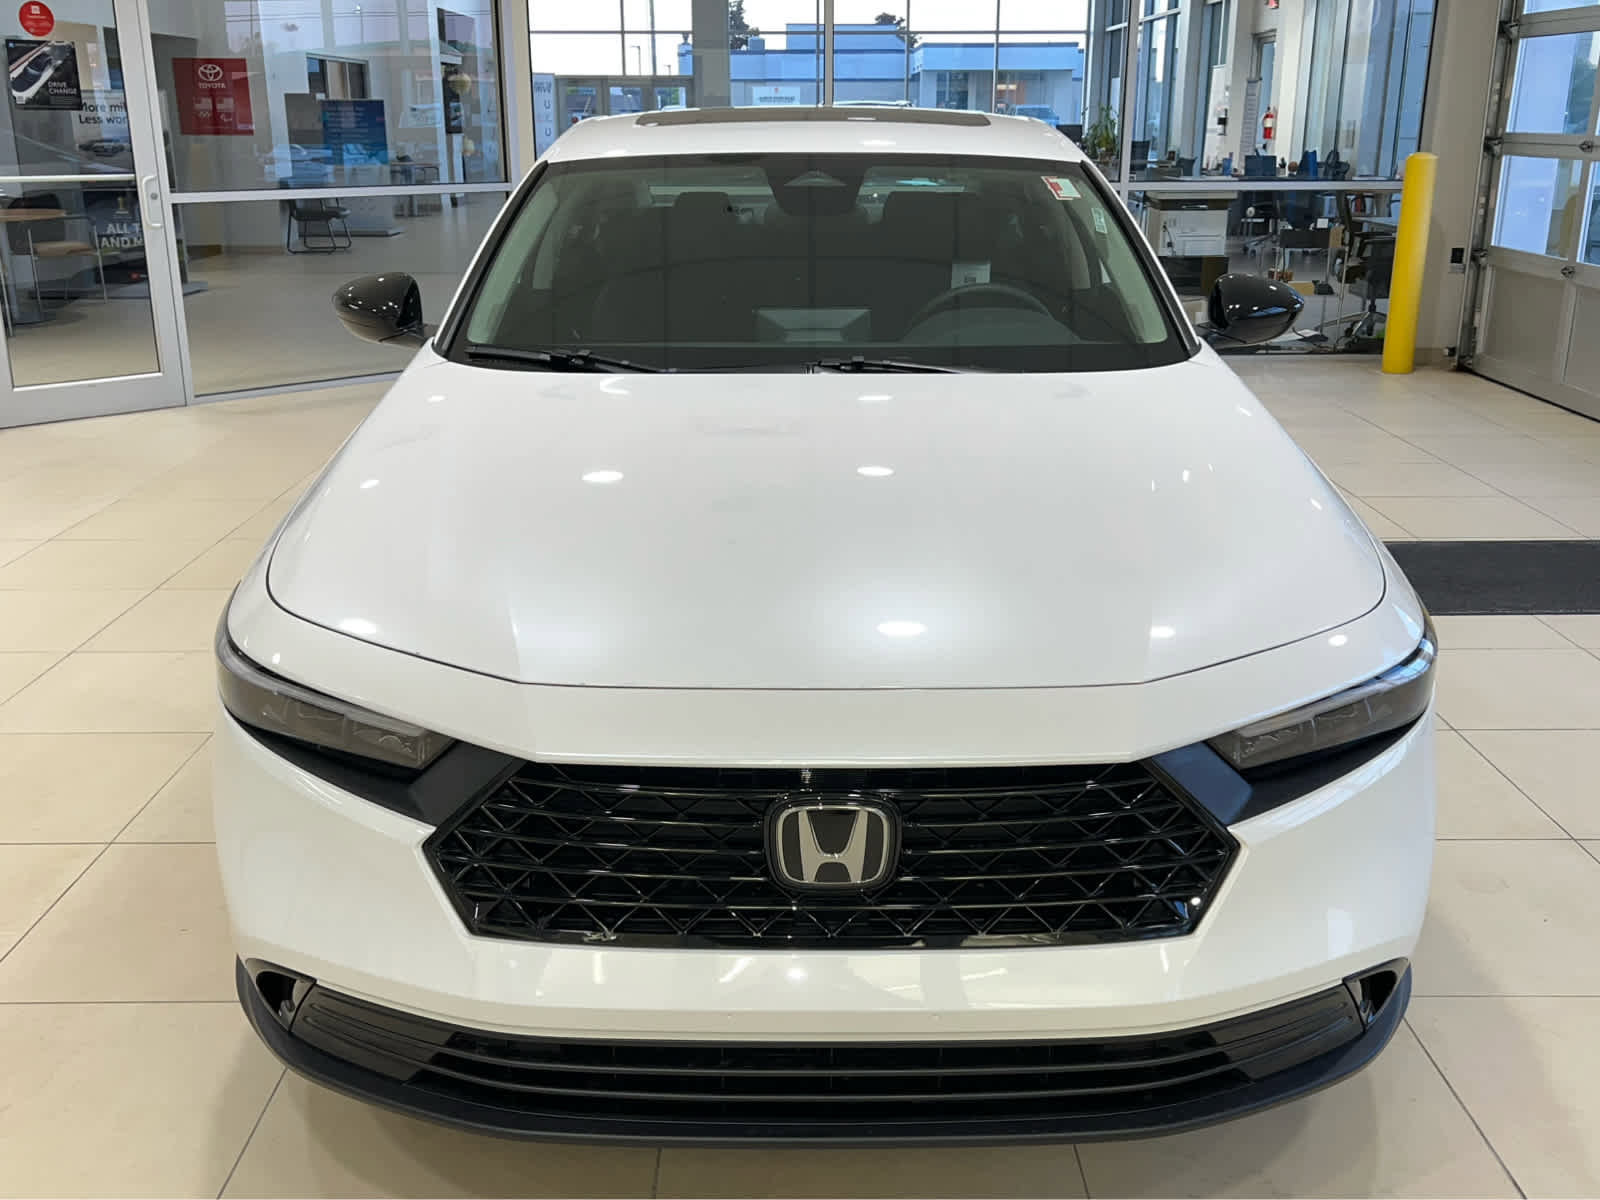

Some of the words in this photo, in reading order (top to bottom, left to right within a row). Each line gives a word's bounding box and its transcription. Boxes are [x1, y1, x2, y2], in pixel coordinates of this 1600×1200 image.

[49, 87, 77, 95] CHANGE
[79, 114, 103, 124] Less
[106, 223, 131, 234] ALL
[101, 236, 130, 248] AND
